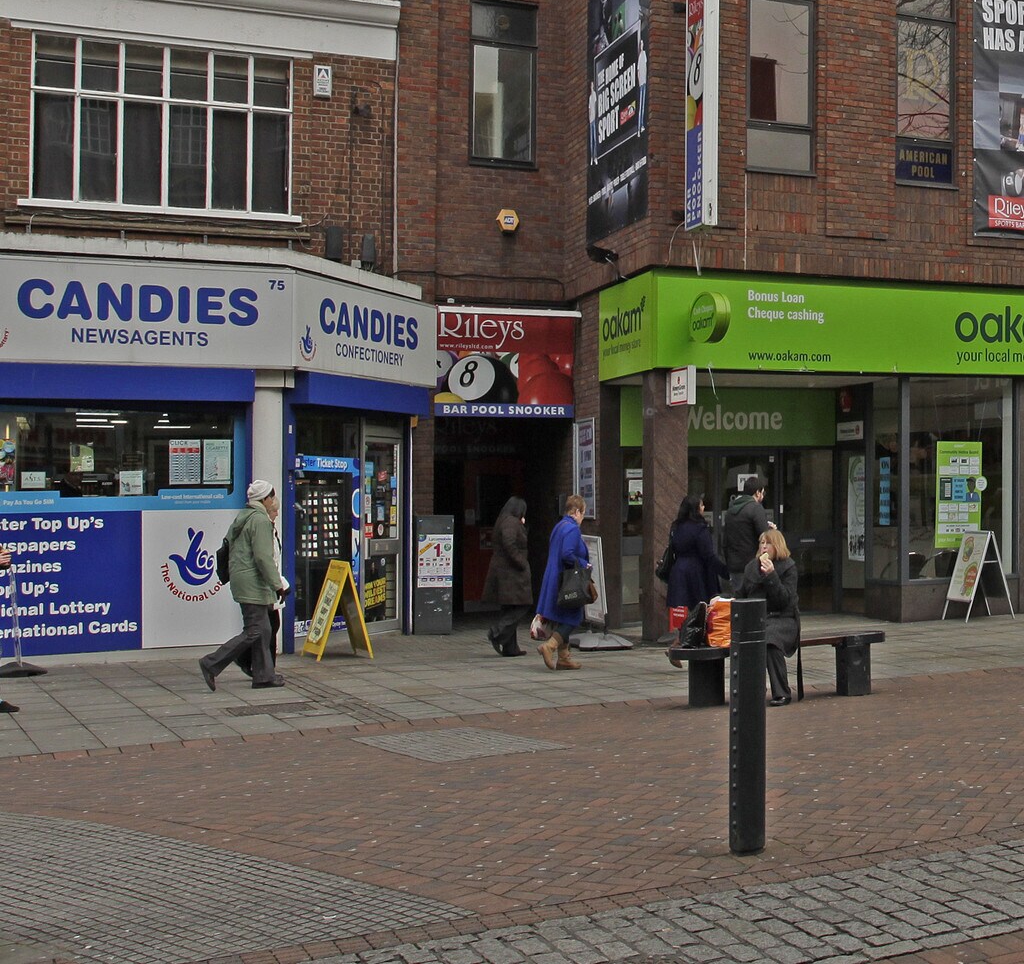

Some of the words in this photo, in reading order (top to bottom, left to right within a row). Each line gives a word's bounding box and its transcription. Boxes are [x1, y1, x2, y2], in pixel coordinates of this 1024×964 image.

[983, 27, 1015, 52] HAS
[606, 58, 618, 84] HOME
[619, 53, 624, 69] OF
[693, 53, 701, 85] 8
[598, 88, 610, 117] BIG
[610, 63, 636, 105] SCREEN
[598, 105, 620, 144] SPORT
[900, 149, 947, 164] AMERICAN
[911, 166, 934, 178] POOL
[269, 280, 285, 290] 75
[17, 278, 258, 326] CANDIES
[748, 290, 779, 303] Bonus
[781, 292, 804, 303] Loan
[319, 298, 418, 350] CANDIES
[692, 316, 713, 331] oakam
[748, 307, 784, 320] Cheque
[787, 309, 824, 324] cashing
[439, 314, 524, 349] Rileys
[603, 308, 642, 341] oakam
[72, 328, 208, 346] NEWSAGENTS
[336, 343, 404, 366] CONFECTIONERY
[440, 342, 493, 350] www.rileysltd.com
[749, 350, 831, 362] www.oakam.com
[957, 351, 983, 365] your
[986, 348, 1009, 362] local
[459, 360, 478, 387] 8
[443, 405, 467, 414] BAR
[472, 405, 504, 415] POOL
[509, 406, 565, 415] SNOOKER
[688, 404, 782, 430] Welcome
[317, 458, 334, 468] Ticket
[335, 459, 348, 471] Stop
[32, 517, 62, 532] Top
[68, 517, 104, 532] Up's
[22, 582, 59, 597] Up's
[160, 563, 170, 583] The
[167, 582, 208, 602] National
[1, 603, 44, 617] ional
[50, 601, 110, 615] Lottery
[88, 620, 137, 634] Cards
